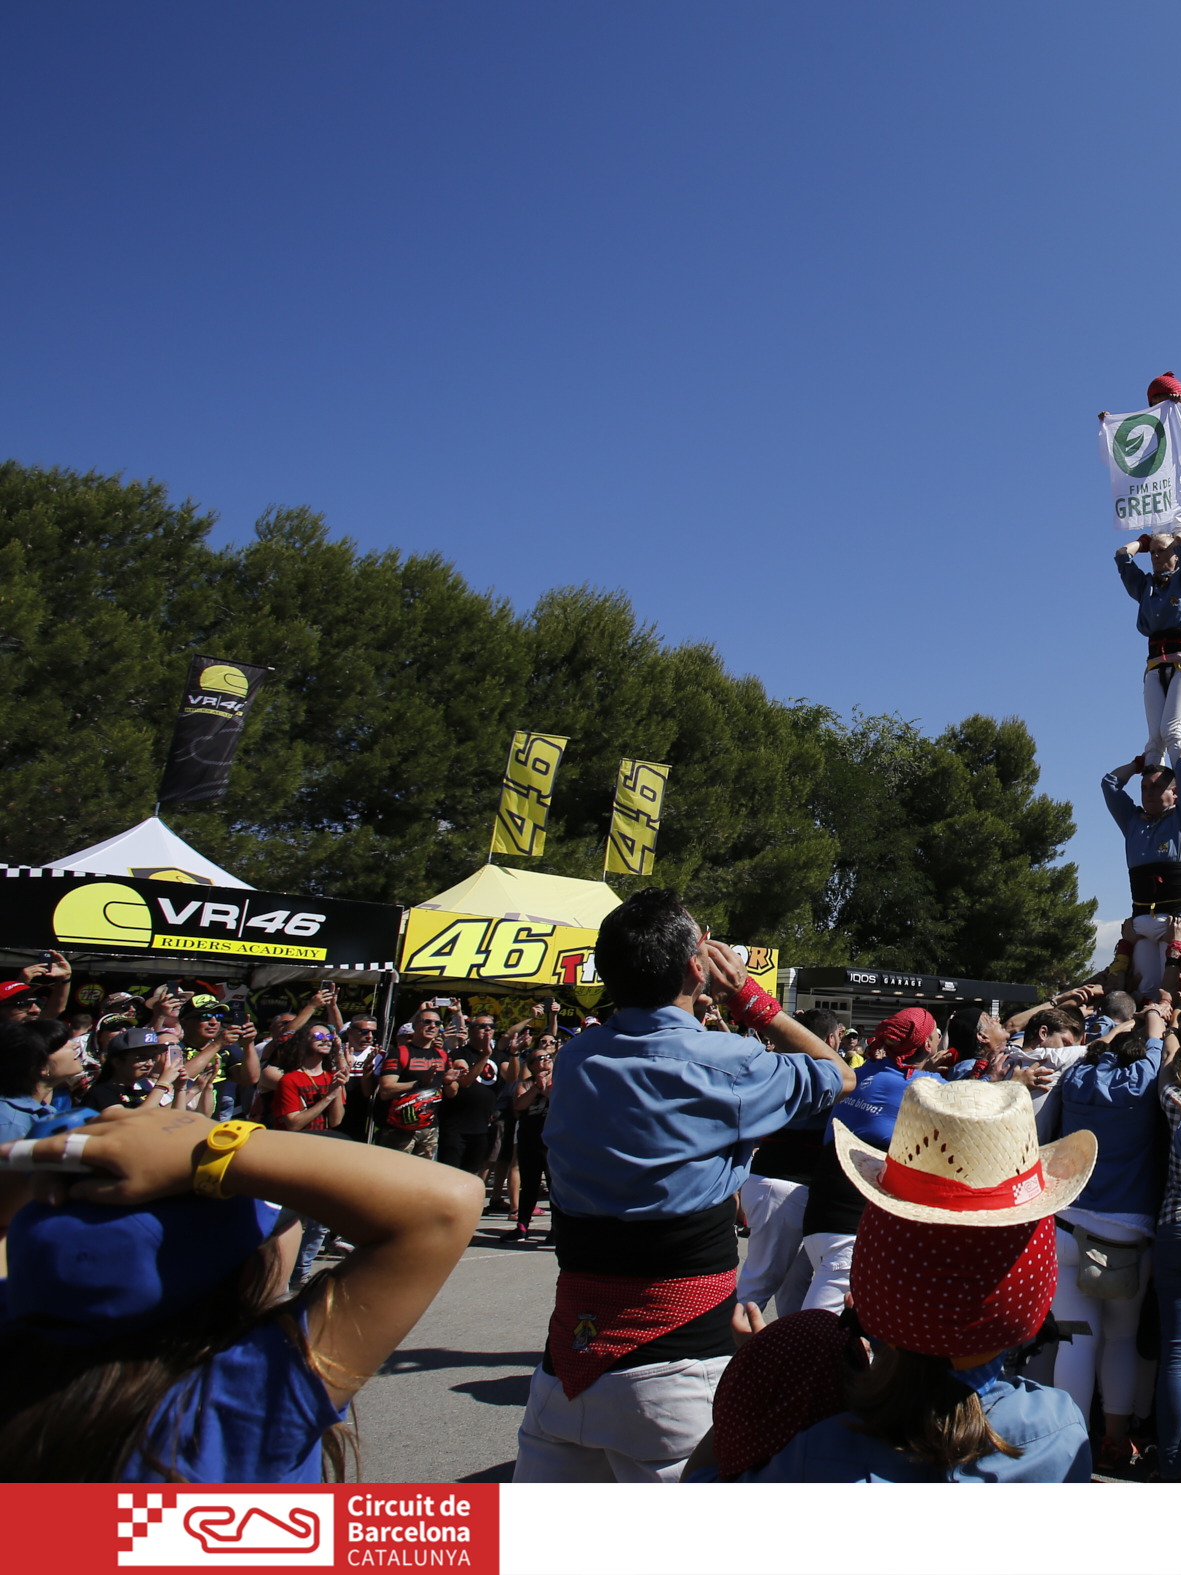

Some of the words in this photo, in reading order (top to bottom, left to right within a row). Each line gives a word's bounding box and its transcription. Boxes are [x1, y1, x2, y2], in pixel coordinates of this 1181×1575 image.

[1129, 483, 1149, 495] FIM
[1152, 477, 1171, 490] RIDE
[1115, 490, 1172, 519] GREEN
[499, 732, 564, 857] 46
[609, 761, 668, 875] 46
[161, 937, 232, 951] RIDERS
[236, 943, 320, 959] ACADEMY
[408, 919, 556, 979] 46
[850, 973, 877, 984] IQOS
[883, 977, 922, 987] GARAGE
